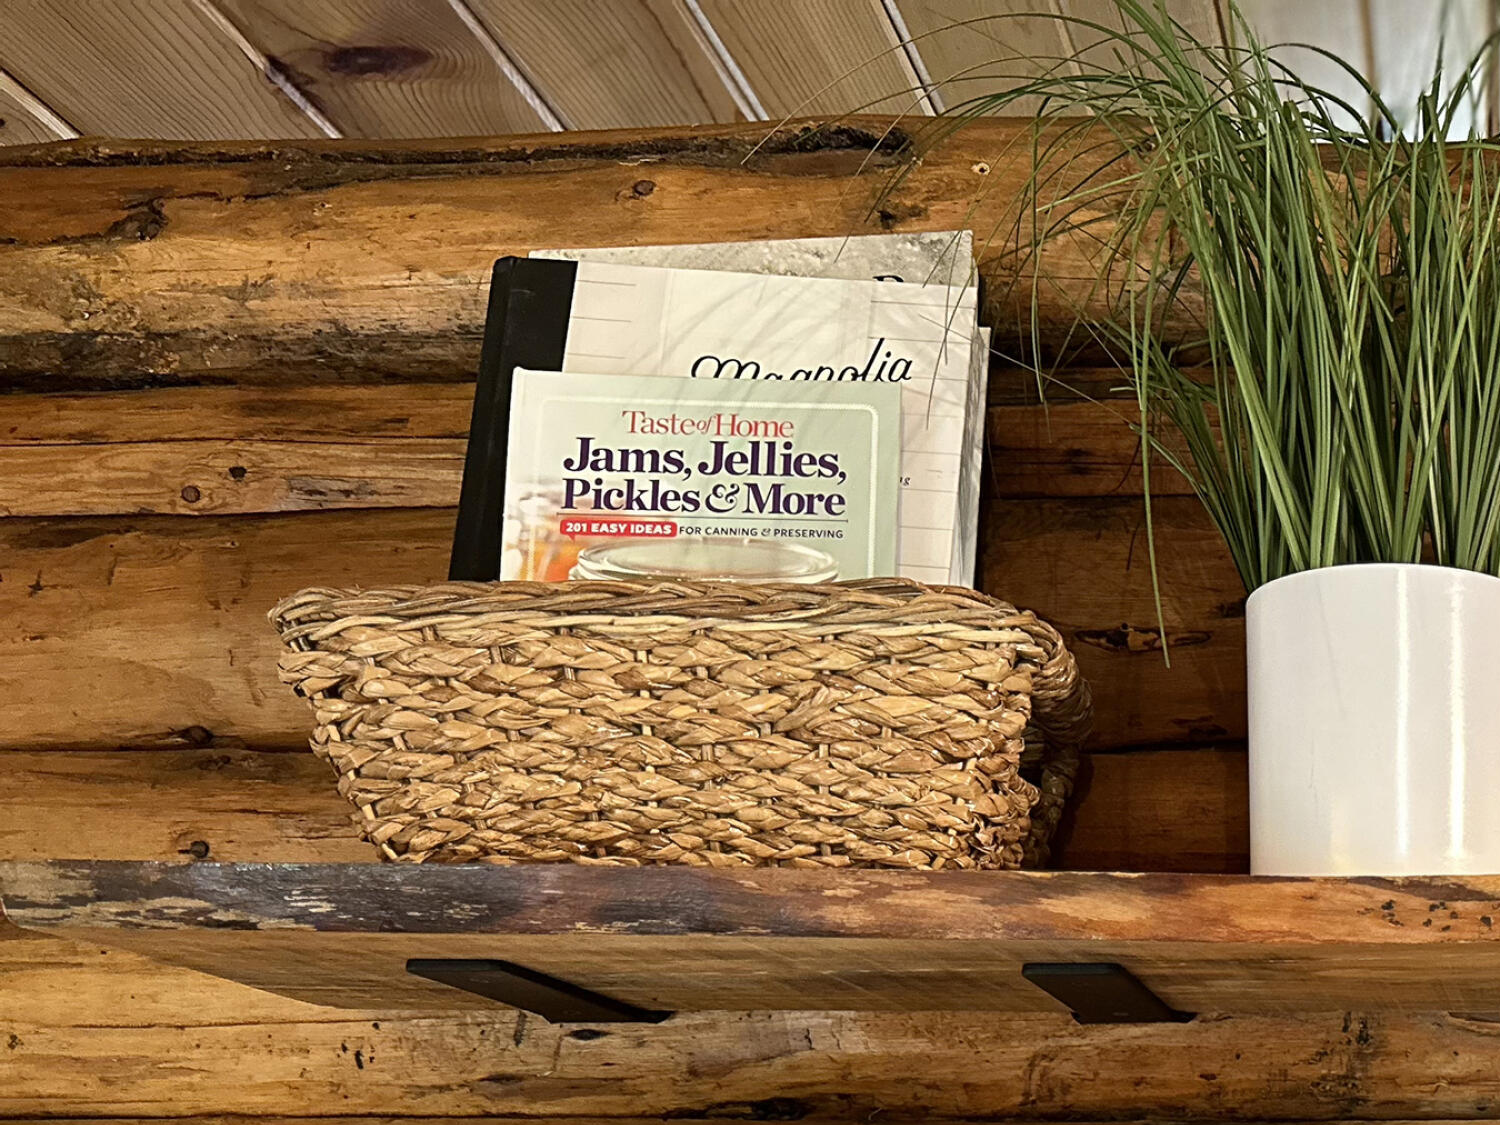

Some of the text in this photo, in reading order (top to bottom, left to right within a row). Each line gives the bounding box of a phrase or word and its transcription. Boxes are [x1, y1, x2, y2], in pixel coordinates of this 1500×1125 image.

[622, 410, 794, 438] Taste of Home
[563, 437, 847, 485] Jams, Jellies,
[561, 477, 846, 516] Pickles & More
[566, 523, 844, 539] 201 EASY IDEAS FOR CANNING & PRESERVING
